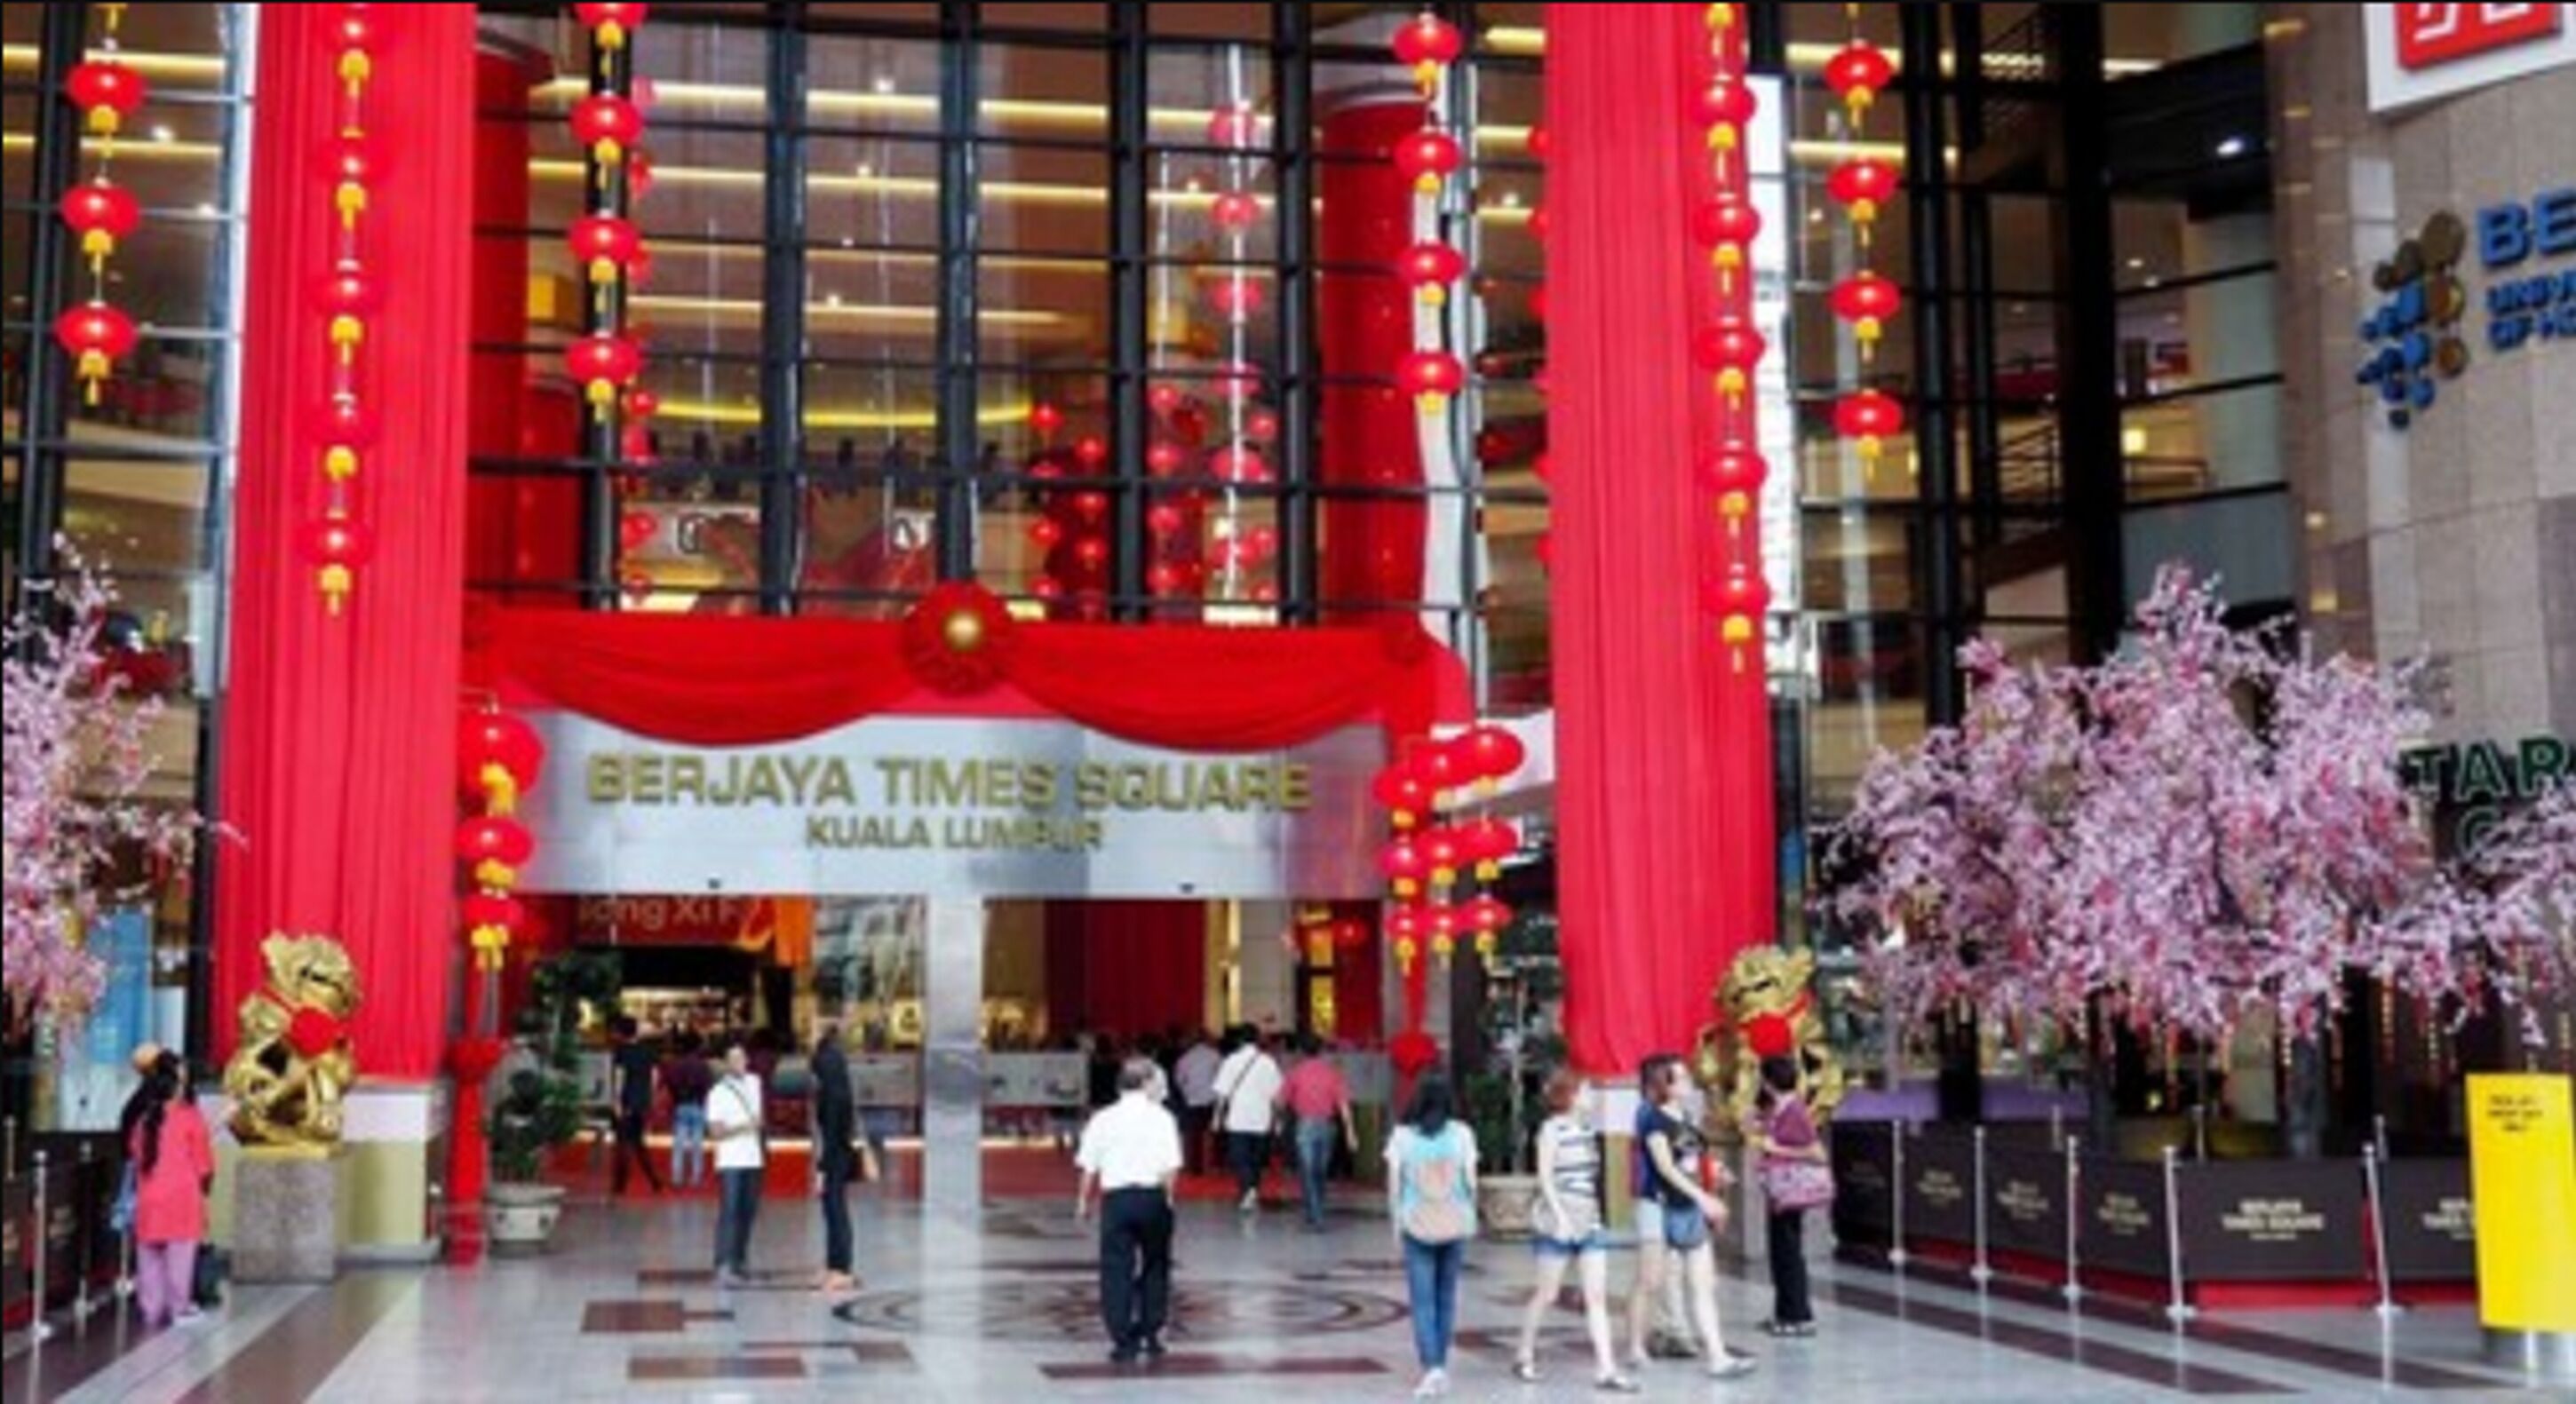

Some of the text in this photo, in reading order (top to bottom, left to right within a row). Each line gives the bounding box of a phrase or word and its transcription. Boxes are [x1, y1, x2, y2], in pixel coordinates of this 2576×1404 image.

[588, 754, 1314, 813] BERJAYA TIMES SQUARE
[806, 815, 1102, 853] KUALA LUMPUR
